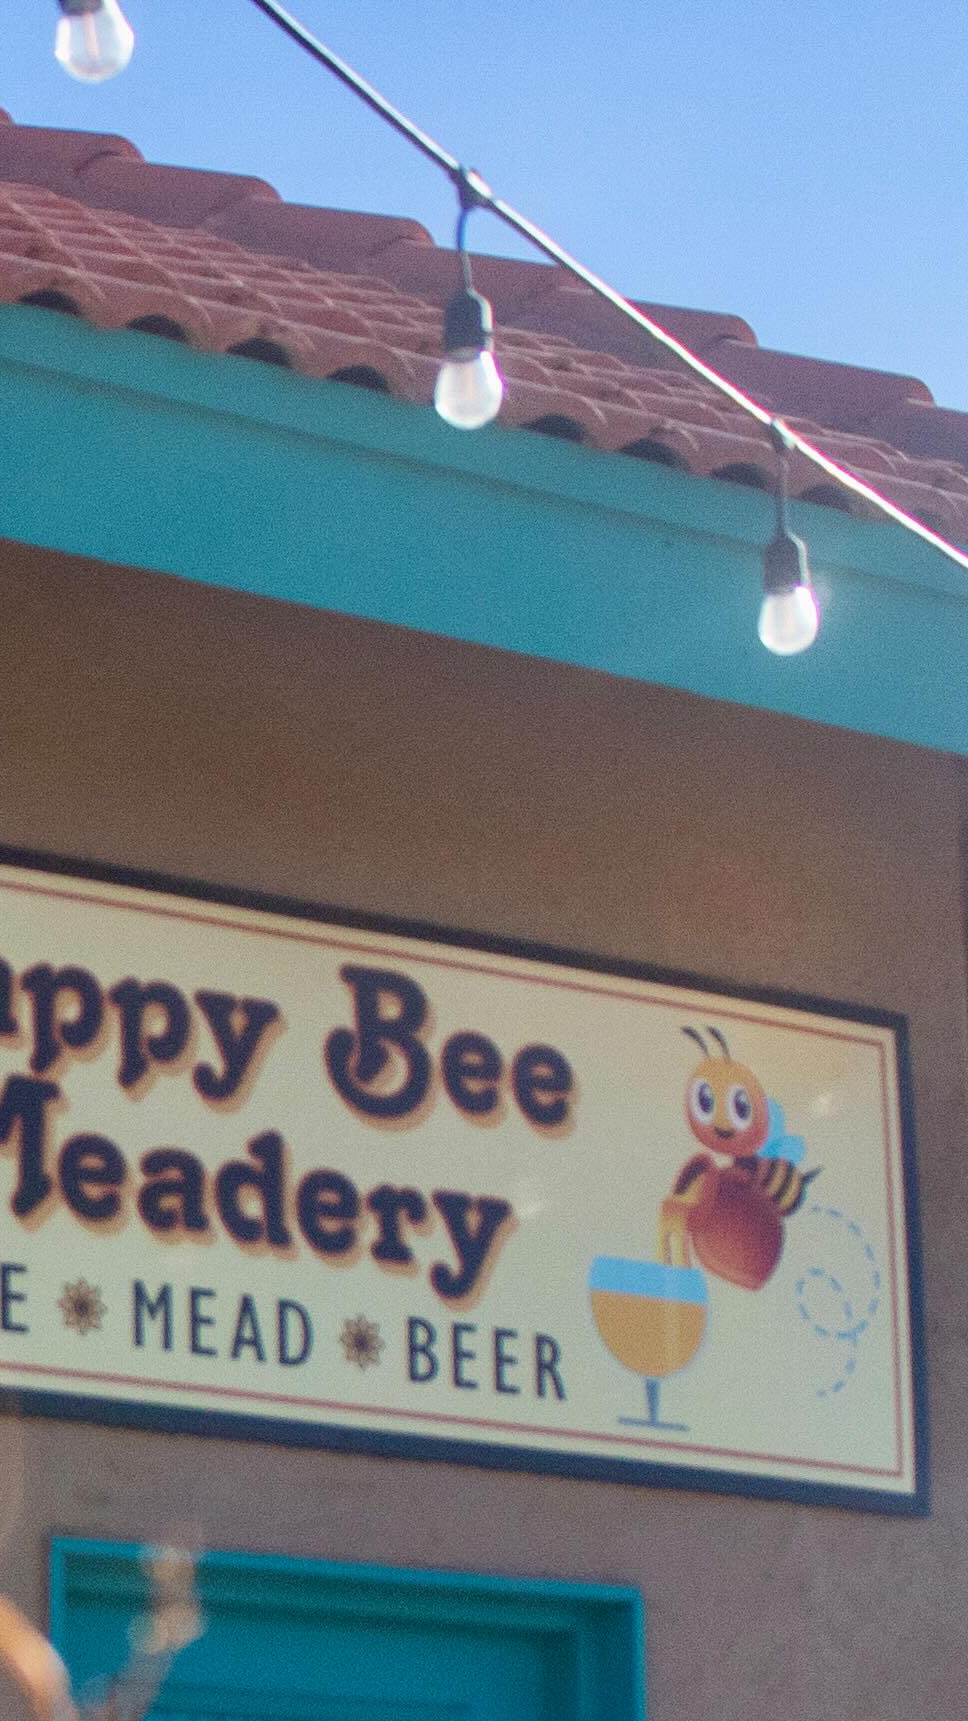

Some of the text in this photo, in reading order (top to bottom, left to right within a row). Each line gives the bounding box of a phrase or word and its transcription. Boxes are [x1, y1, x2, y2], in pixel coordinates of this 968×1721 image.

[322, 964, 577, 1127] Bee
[131, 1279, 316, 1370] MEAD
[406, 1315, 568, 1402] BEER
